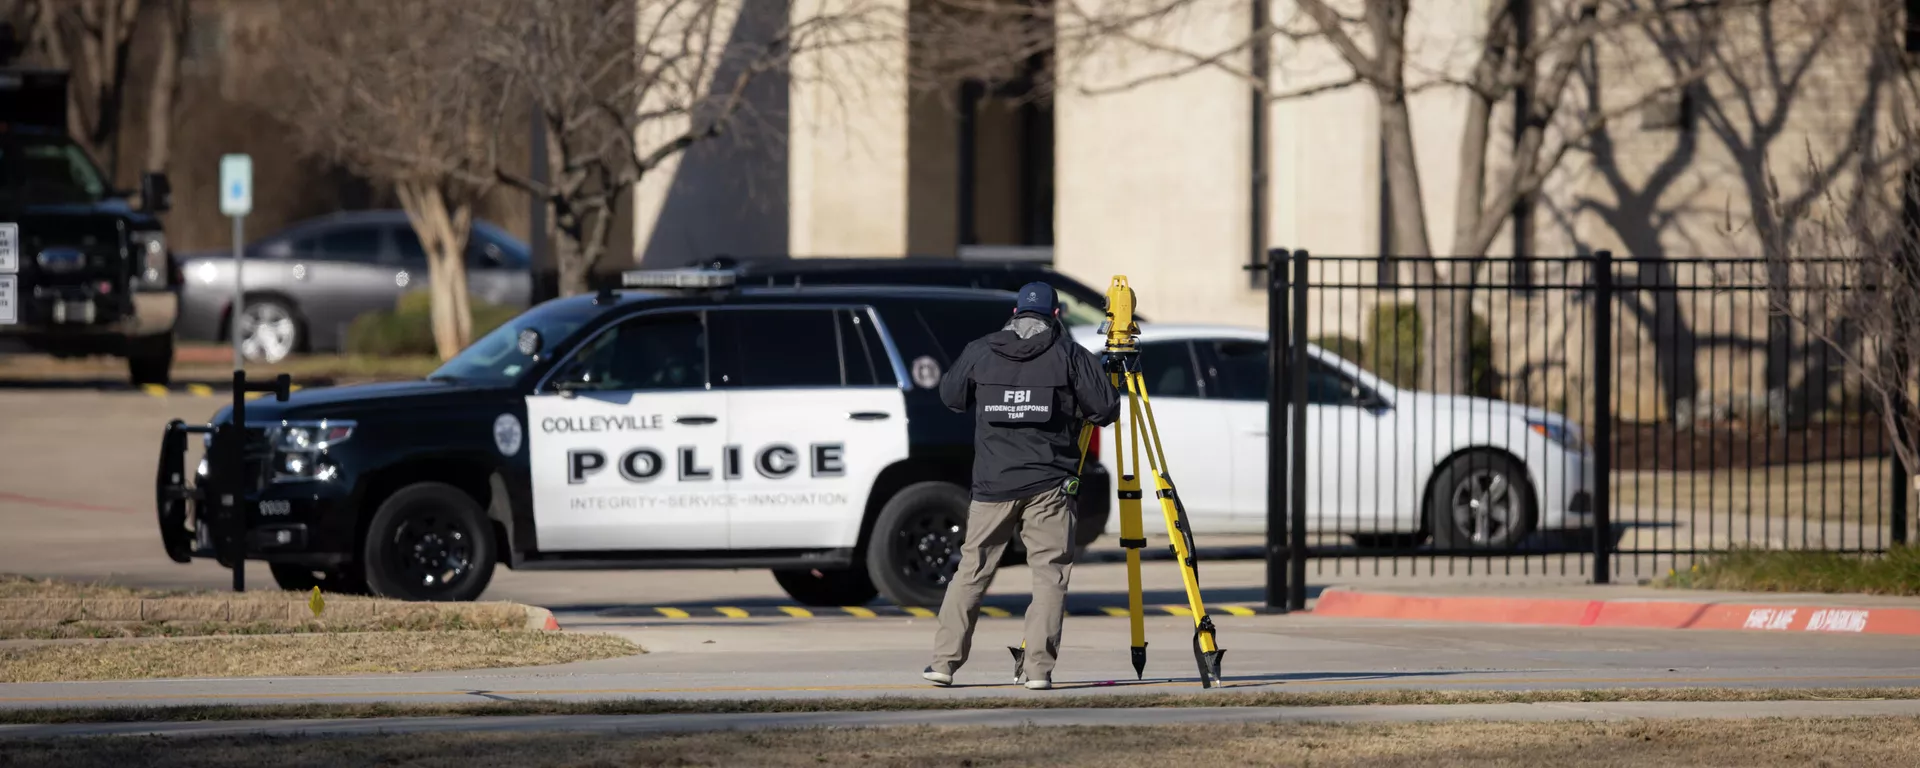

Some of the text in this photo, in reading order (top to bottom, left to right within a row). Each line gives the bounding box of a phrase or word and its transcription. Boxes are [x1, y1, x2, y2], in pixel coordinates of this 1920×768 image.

[1003, 389, 1032, 404] FBI
[984, 404, 1049, 413] EVIDENCE RESPONSE
[541, 414, 664, 433] COLLEYVILLE
[566, 441, 847, 486] POLICE
